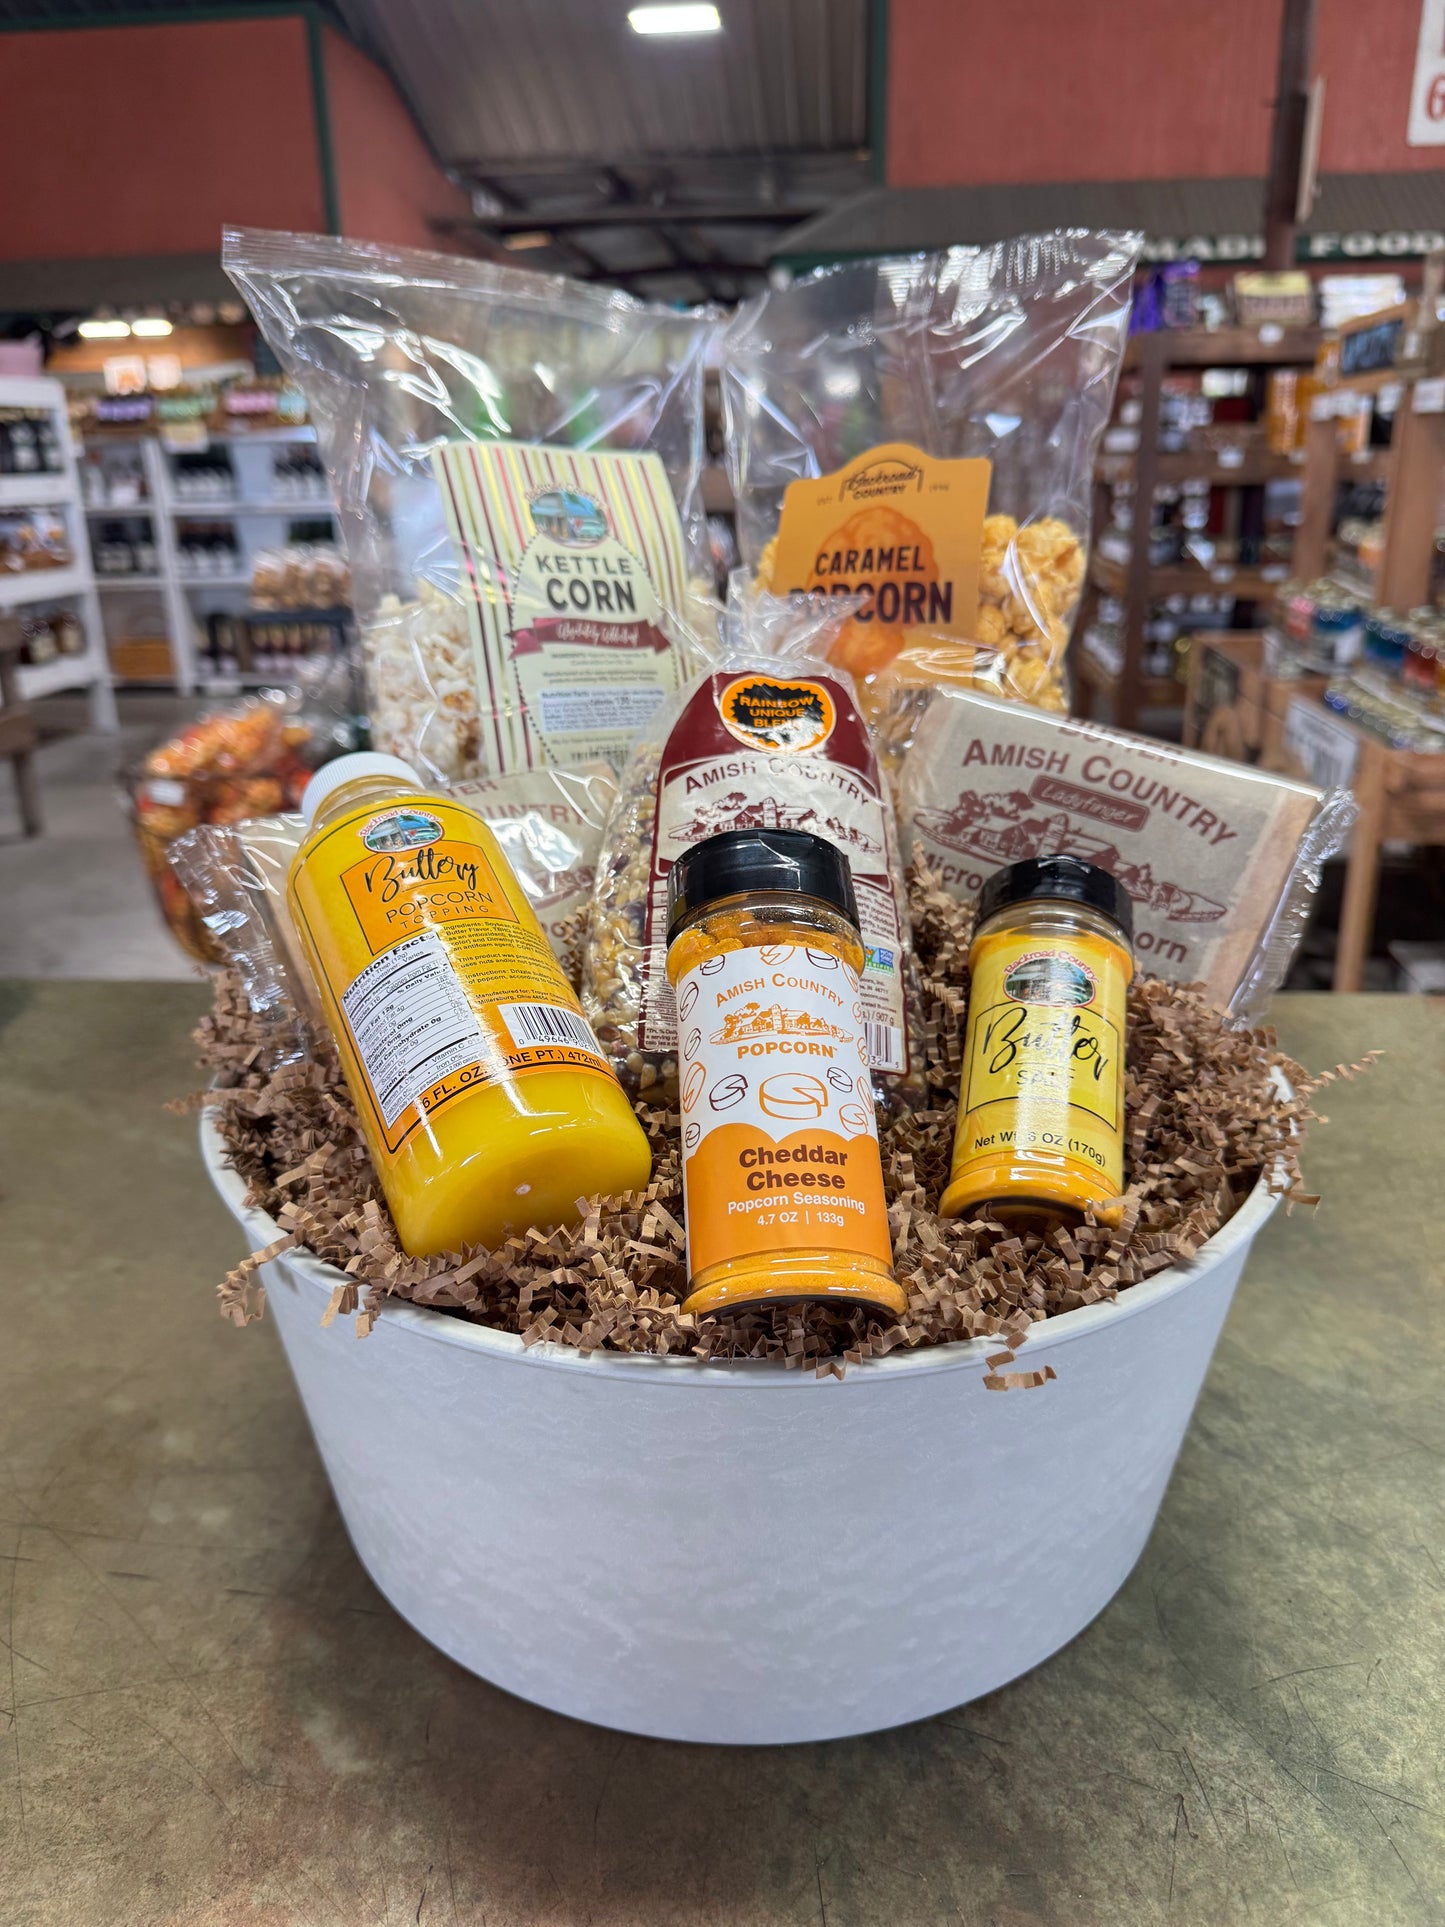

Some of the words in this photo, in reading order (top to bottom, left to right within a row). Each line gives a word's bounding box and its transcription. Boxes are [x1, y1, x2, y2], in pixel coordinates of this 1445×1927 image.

[535, 555, 634, 575] KETTLE
[815, 546, 925, 576] CARAMEL
[546, 577, 638, 614] CORN
[790, 582, 953, 625] CORN
[740, 695, 814, 709] RAINBOW
[750, 708, 806, 718] UNIQUE
[685, 760, 756, 794] AMISH
[768, 757, 869, 805] COUNTRY
[961, 738, 1070, 776] AMISH
[1081, 752, 1239, 847] COUNTRY
[1042, 781, 1141, 826] Ladyfinger
[358, 809, 399, 837] Backroad
[400, 808, 443, 824] Country
[365, 848, 479, 903] Buttery
[385, 891, 494, 924] POPCORN
[400, 905, 490, 929] TOPPING
[342, 956, 390, 1003] Nutrition
[465, 969, 509, 979] Instructions:
[1003, 950, 1057, 975] Backroad
[1057, 950, 1101, 984] Country
[405, 978, 423, 989] Daily
[715, 977, 765, 1009] AMISH
[771, 972, 845, 1008] COUNTRY
[383, 1023, 430, 1060] Carbohydrate
[431, 1047, 458, 1063] Vitamin
[737, 1041, 834, 1060] POPCORN
[432, 1084, 456, 1101] FL.
[459, 1066, 488, 1083] OZ.
[535, 1049, 565, 1062] PT.)
[436, 1060, 450, 1071] Iron
[739, 1144, 848, 1169] Cheddar
[975, 1134, 996, 1150] Net
[1041, 1132, 1064, 1147] OZ
[1067, 1139, 1107, 1168] (170g)
[746, 1171, 846, 1191] Cheese
[727, 1193, 789, 1216] Popcorn
[793, 1191, 866, 1215] Seasoning
[757, 1212, 776, 1227] 4.7
[780, 1211, 799, 1224] OZ
[816, 1211, 845, 1227] 133g
